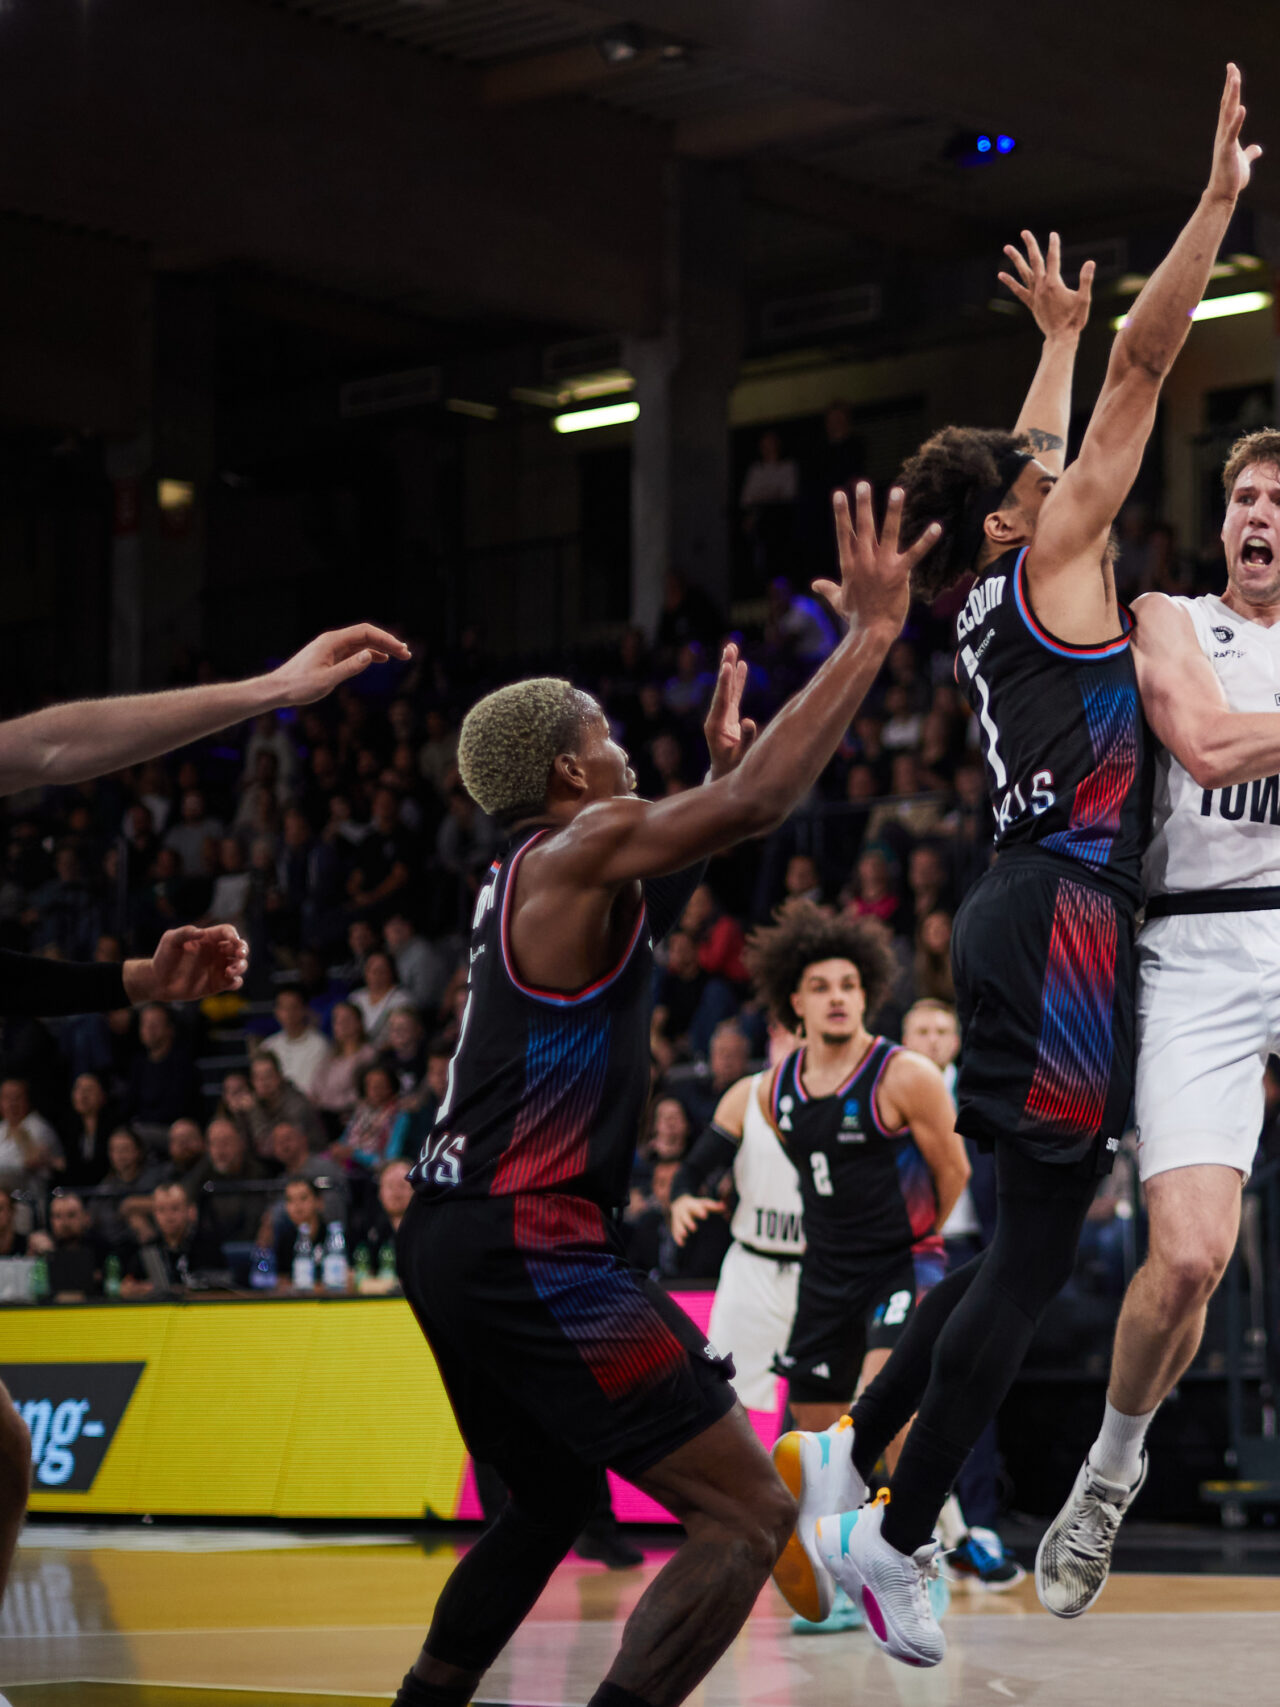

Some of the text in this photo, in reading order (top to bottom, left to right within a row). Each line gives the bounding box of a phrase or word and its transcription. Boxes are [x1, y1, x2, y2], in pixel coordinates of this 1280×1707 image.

[810, 1151, 834, 1197] 2
[883, 1289, 912, 1326] 2
[12, 1396, 106, 1487] ng-
